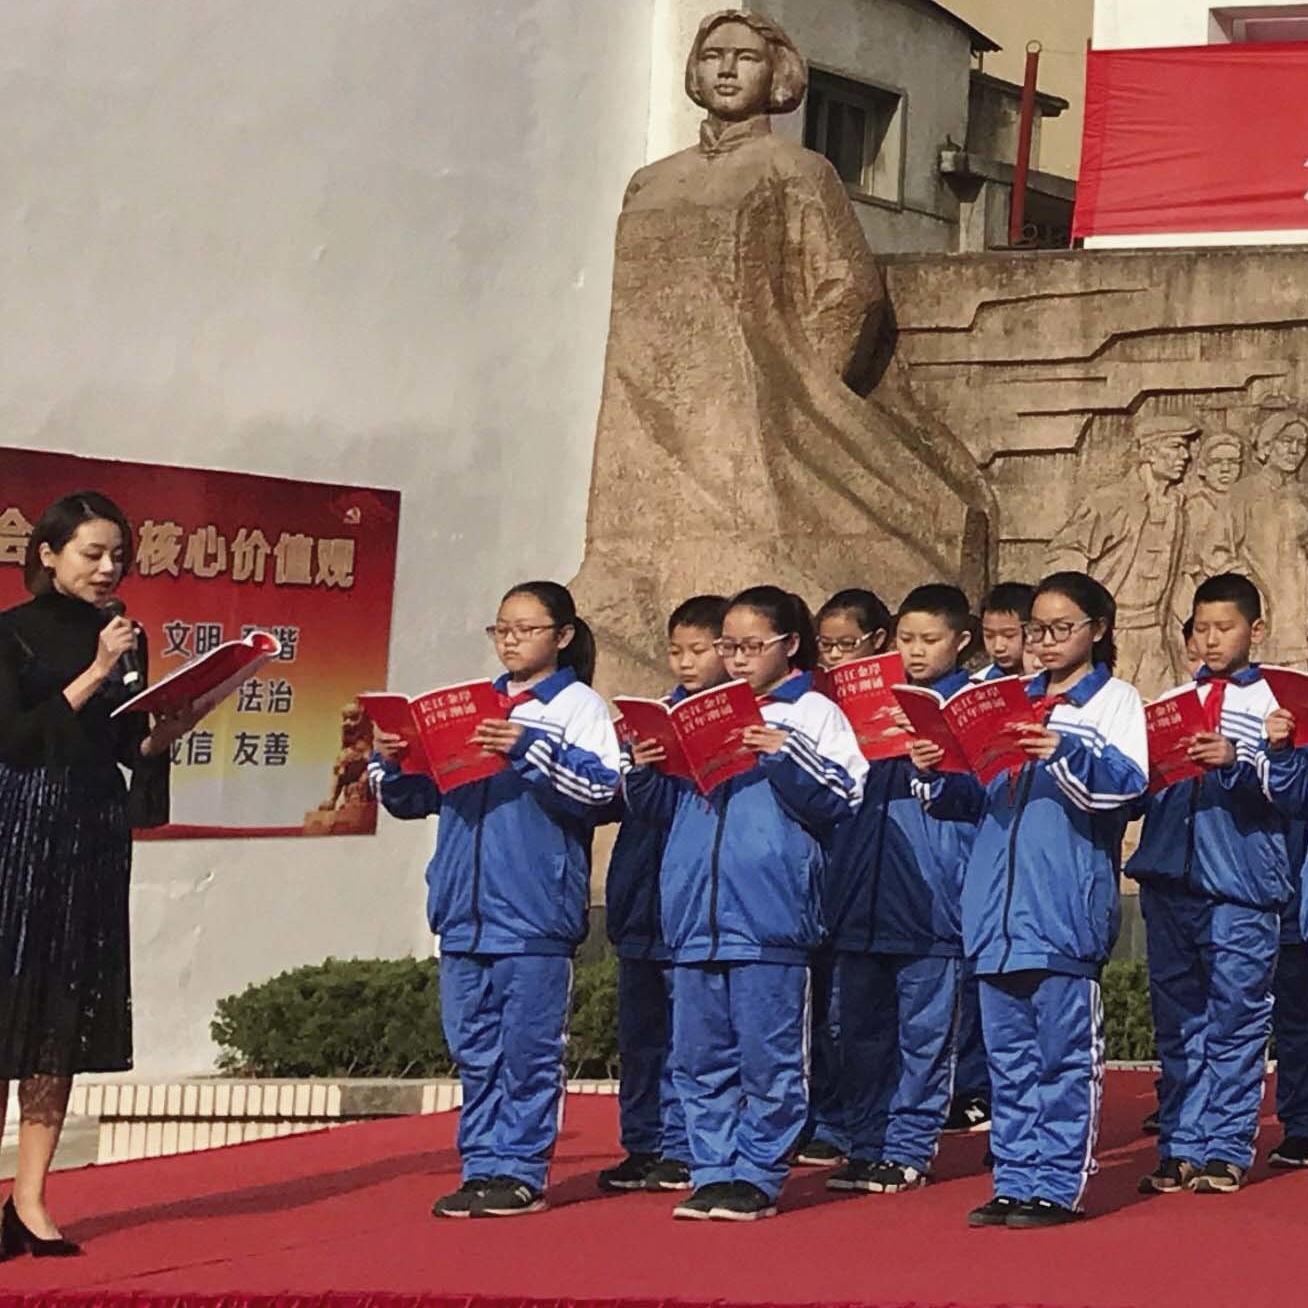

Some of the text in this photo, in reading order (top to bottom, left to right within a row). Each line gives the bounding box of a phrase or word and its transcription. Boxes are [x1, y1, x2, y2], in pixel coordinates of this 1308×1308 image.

[136, 520, 355, 588] 核心价值观
[237, 679, 293, 713] 法治
[233, 732, 290, 767] 友善
